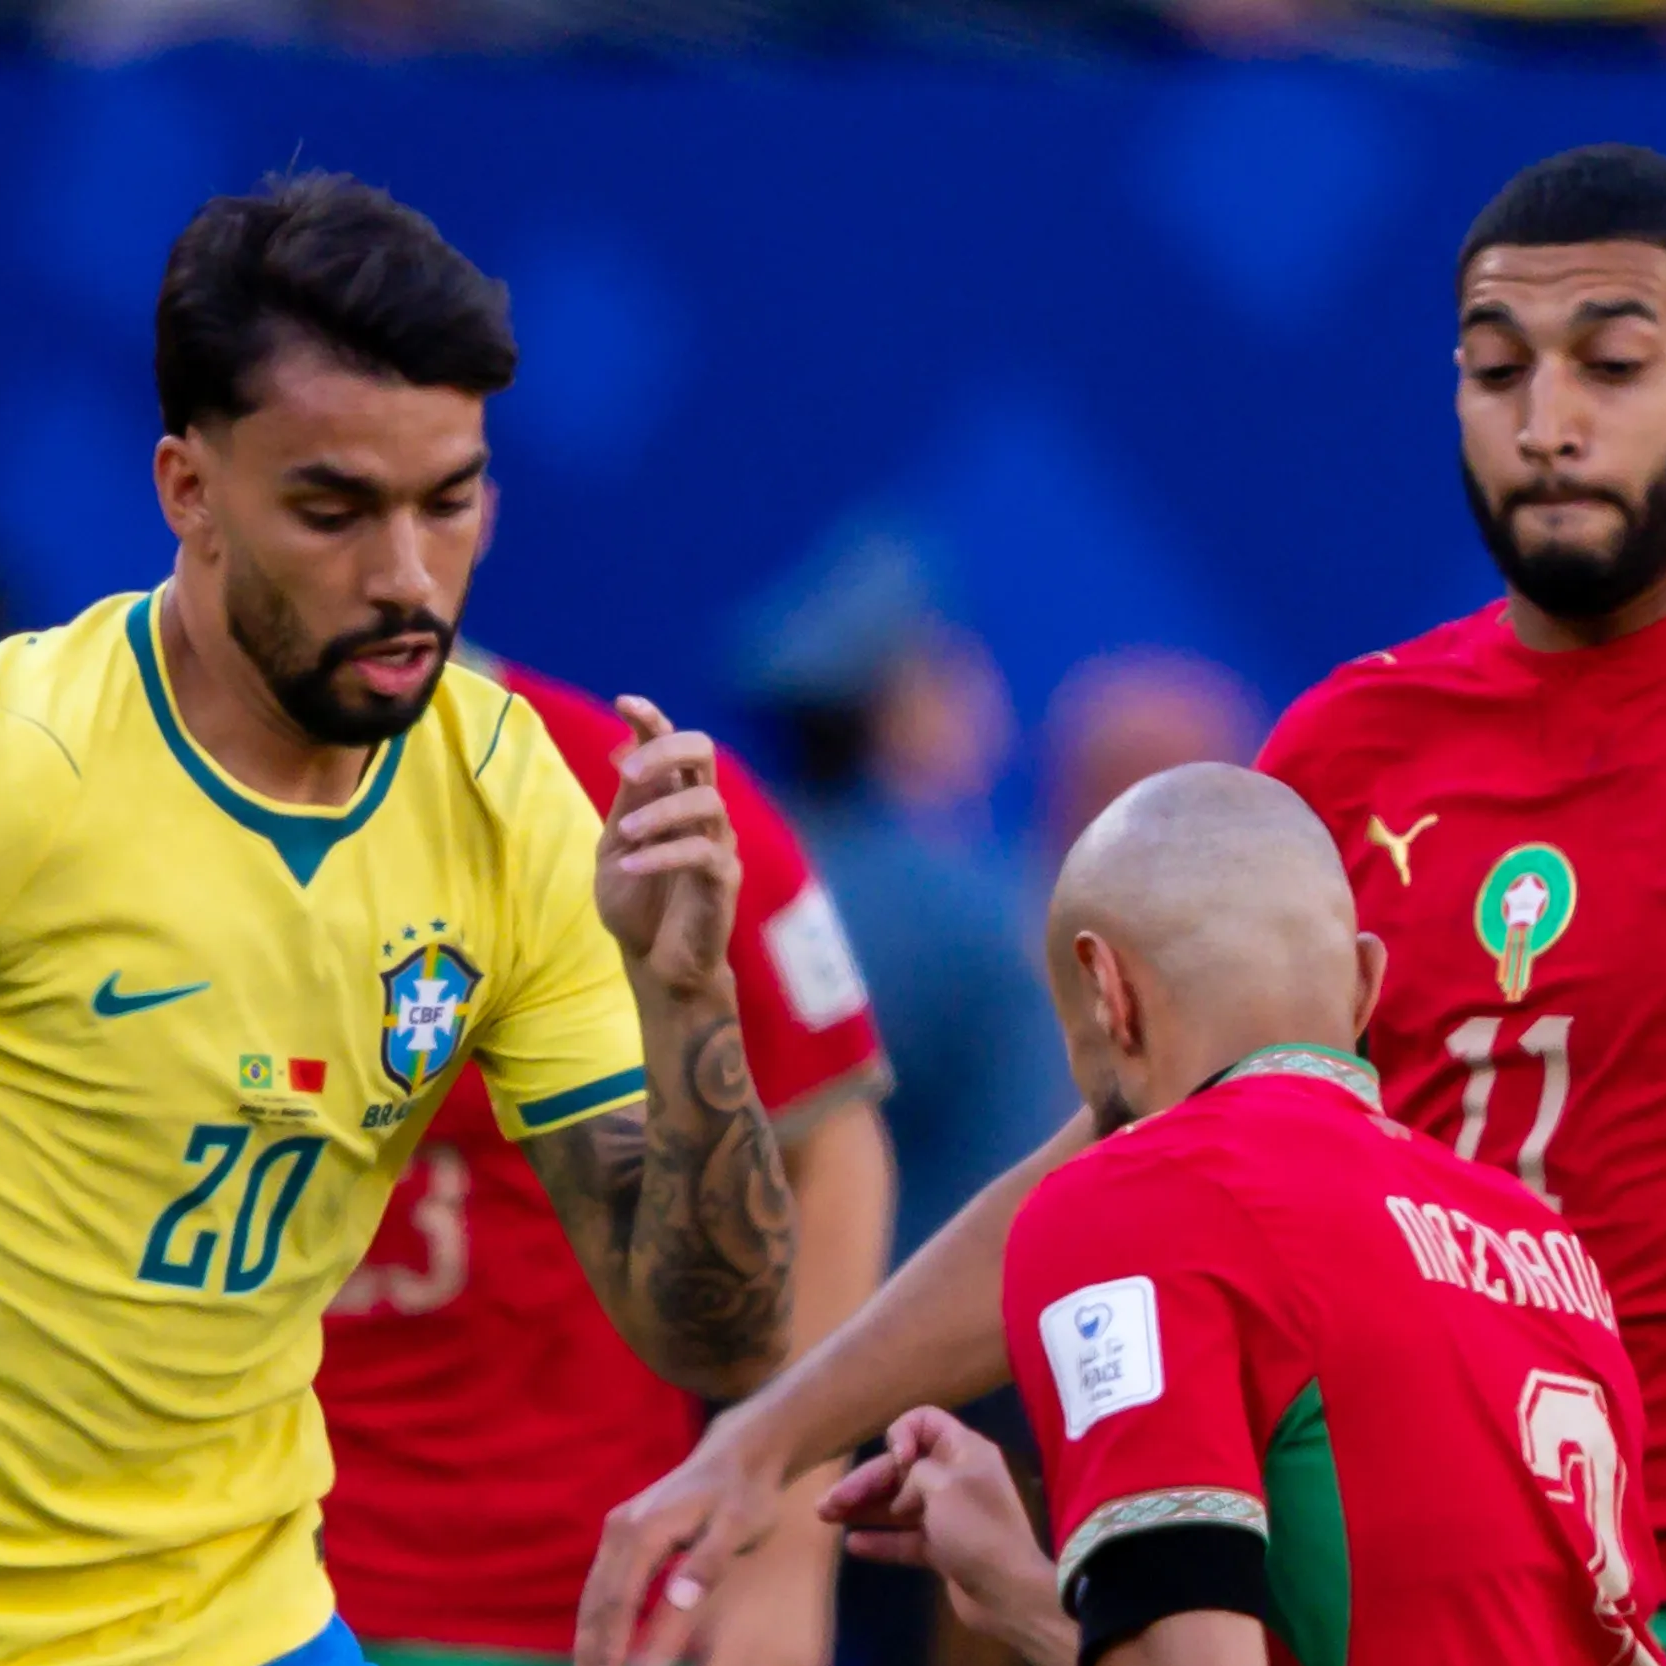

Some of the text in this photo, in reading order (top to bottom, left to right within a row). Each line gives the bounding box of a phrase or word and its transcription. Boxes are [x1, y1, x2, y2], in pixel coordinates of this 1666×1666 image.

[409, 1005, 446, 1026] CBF
[360, 1098, 416, 1129] BRA
[1444, 1014, 1574, 1215] 11
[137, 1124, 327, 1294] 20
[328, 1143, 470, 1315] 3
[1385, 1195, 1619, 1337] MAZRAOU
